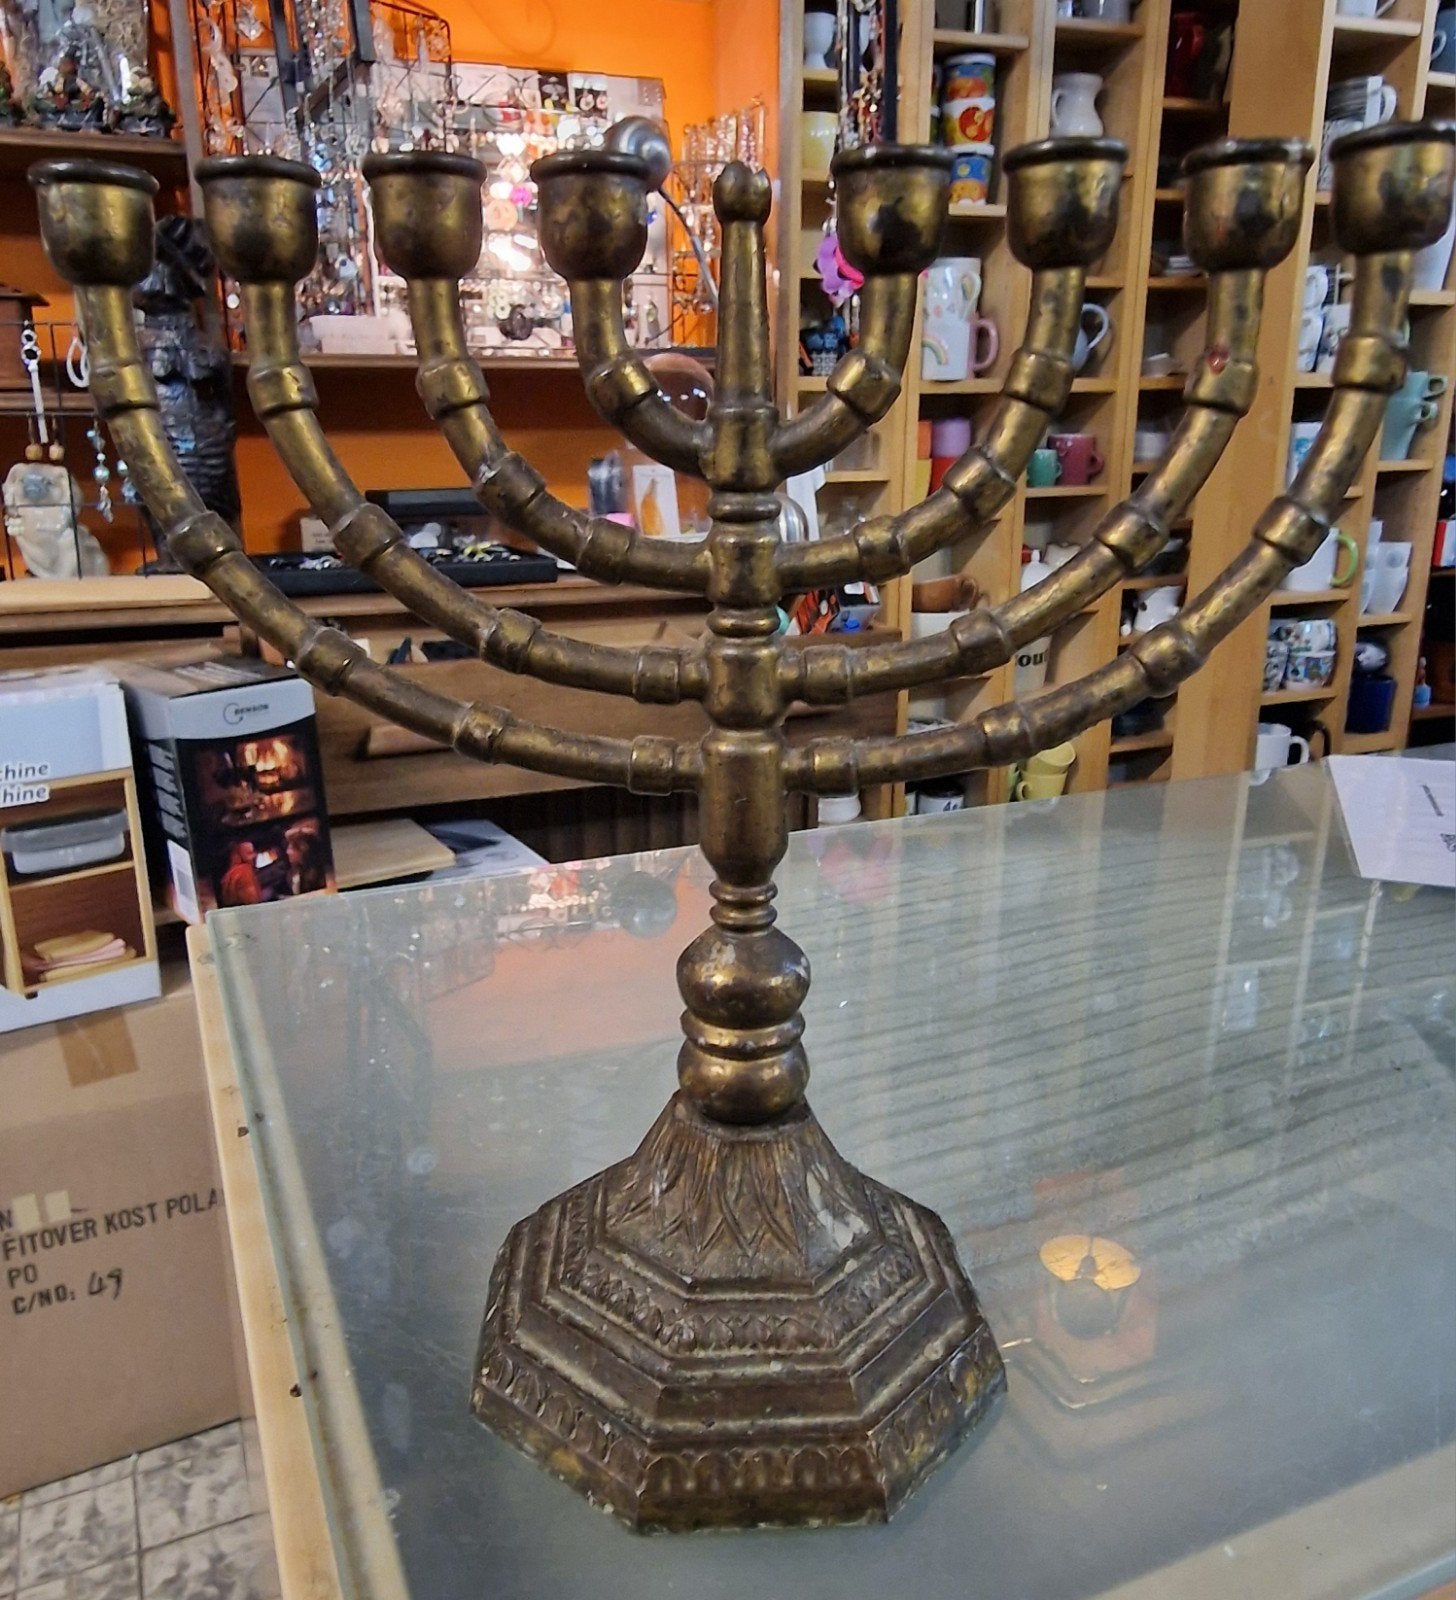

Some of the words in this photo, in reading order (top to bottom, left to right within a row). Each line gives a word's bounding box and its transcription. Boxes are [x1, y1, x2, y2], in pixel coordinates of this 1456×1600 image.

[0, 763, 49, 780] hine
[3, 1218, 98, 1262] FITOVER
[104, 1202, 158, 1235] KOST
[166, 1187, 219, 1220] POLA
[7, 1263, 39, 1290] PO
[86, 1267, 123, 1300] 49
[12, 1283, 76, 1315] C/NO:
